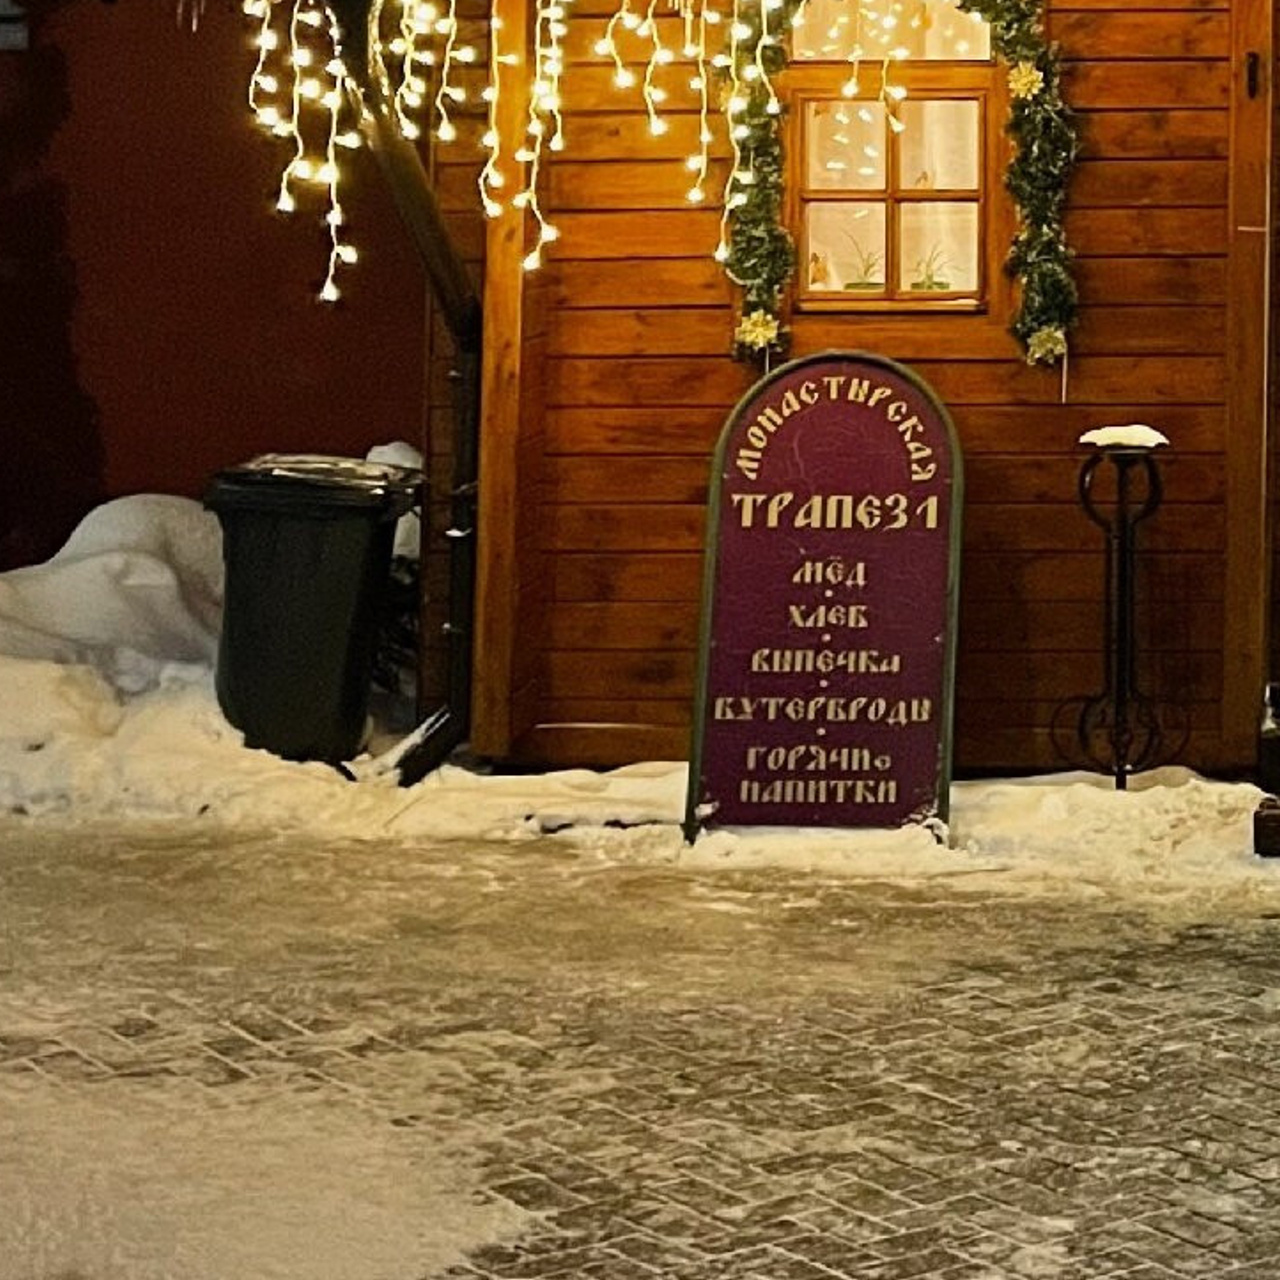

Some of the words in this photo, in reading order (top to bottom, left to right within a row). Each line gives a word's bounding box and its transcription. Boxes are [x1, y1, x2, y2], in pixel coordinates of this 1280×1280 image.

[735, 375, 938, 481] МОНАСТЫРСКАЯ
[792, 556, 868, 587] МЁД
[789, 605, 869, 628] ХЛЕБ
[751, 648, 901, 673] ВЫПЕЧКА
[714, 696, 932, 726] БУТЕРБРОДЫ
[739, 780, 897, 804] НАПИТКИ
